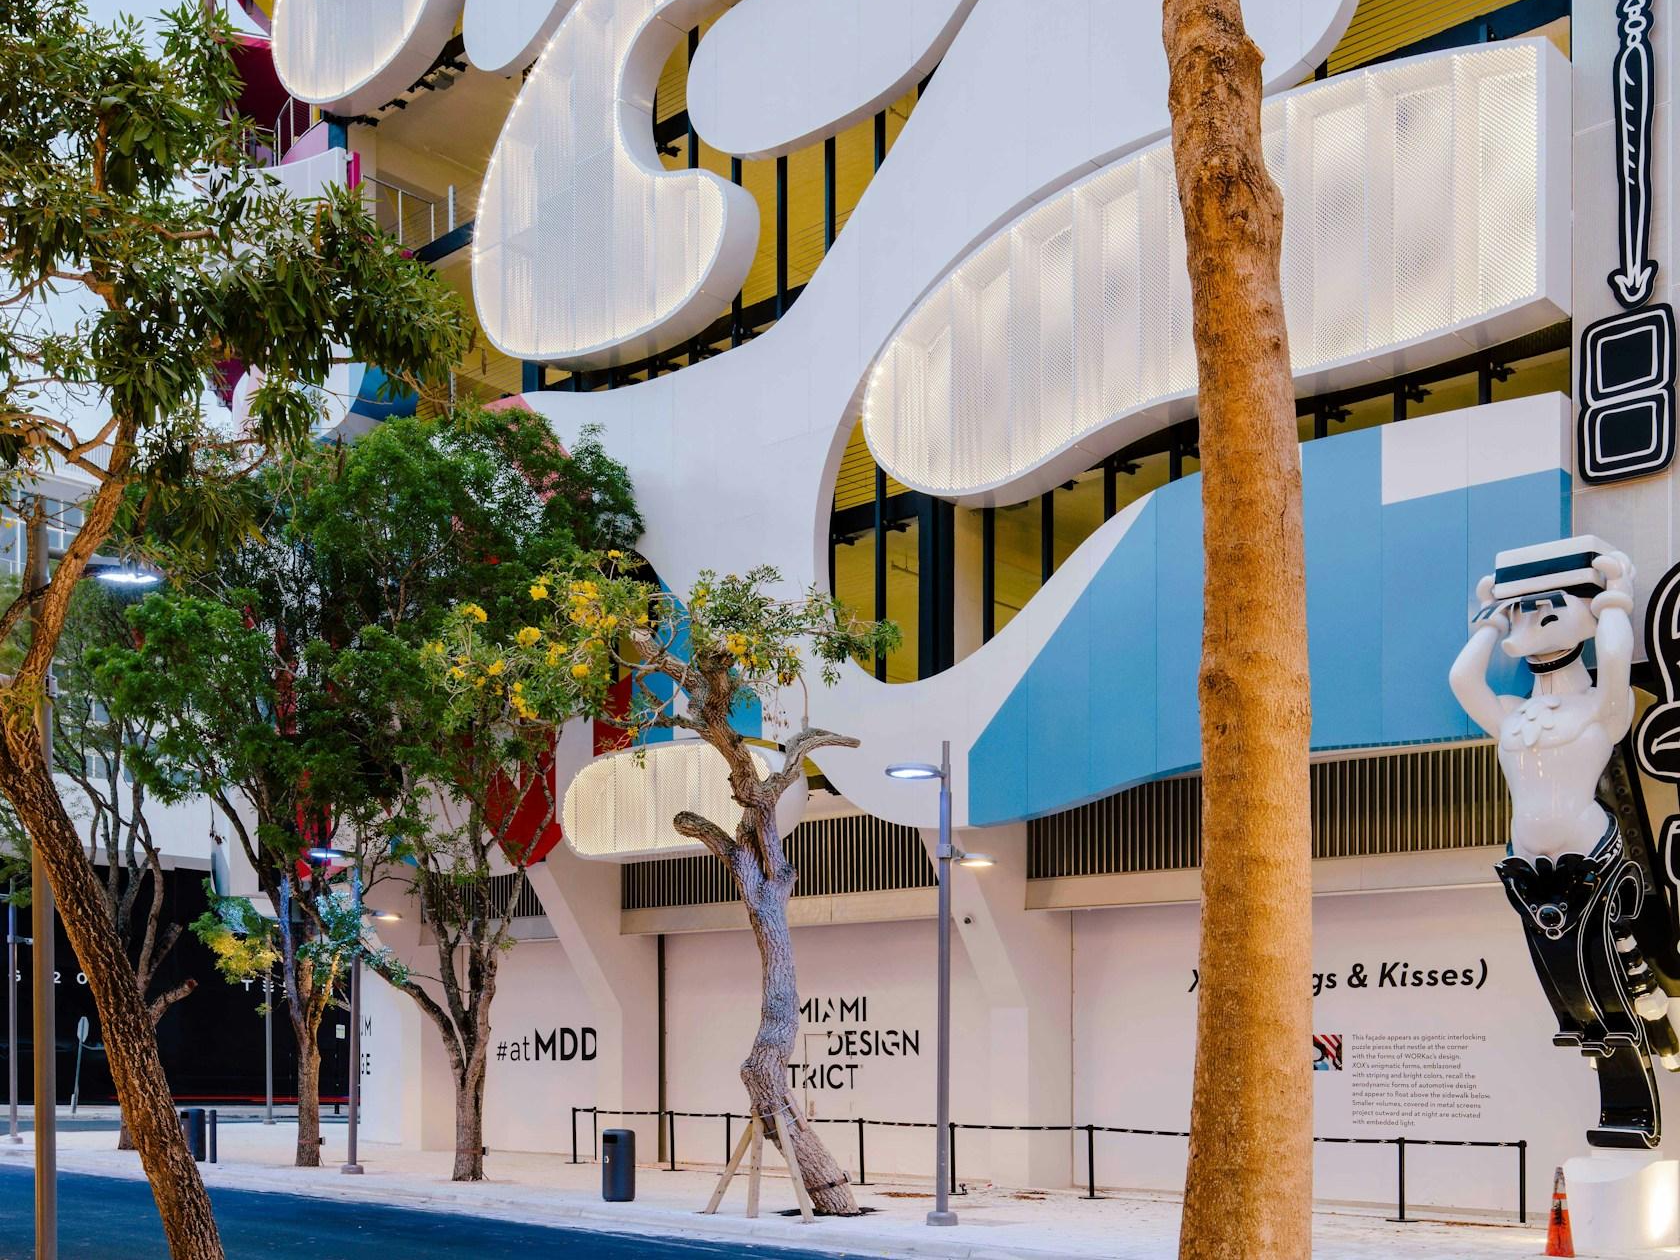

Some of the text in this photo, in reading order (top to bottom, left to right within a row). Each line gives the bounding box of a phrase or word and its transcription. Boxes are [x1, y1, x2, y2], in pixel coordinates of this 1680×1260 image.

[1347, 962, 1368, 989] &
[1378, 958, 1488, 990] Kisses)
[799, 995, 867, 1023] MIAMI
[1448, 1033, 1486, 1041] interlocking
[826, 1029, 920, 1057] DESIGN
[1371, 1062, 1401, 1070] enigmatic
[787, 1063, 859, 1090] TRICT
[1403, 1072, 1422, 1080] bright
[1352, 1081, 1391, 1089] aerodynamic
[1455, 1082, 1477, 1090] design
[1421, 1111, 1438, 1119] night
[1451, 1111, 1481, 1119] activated
